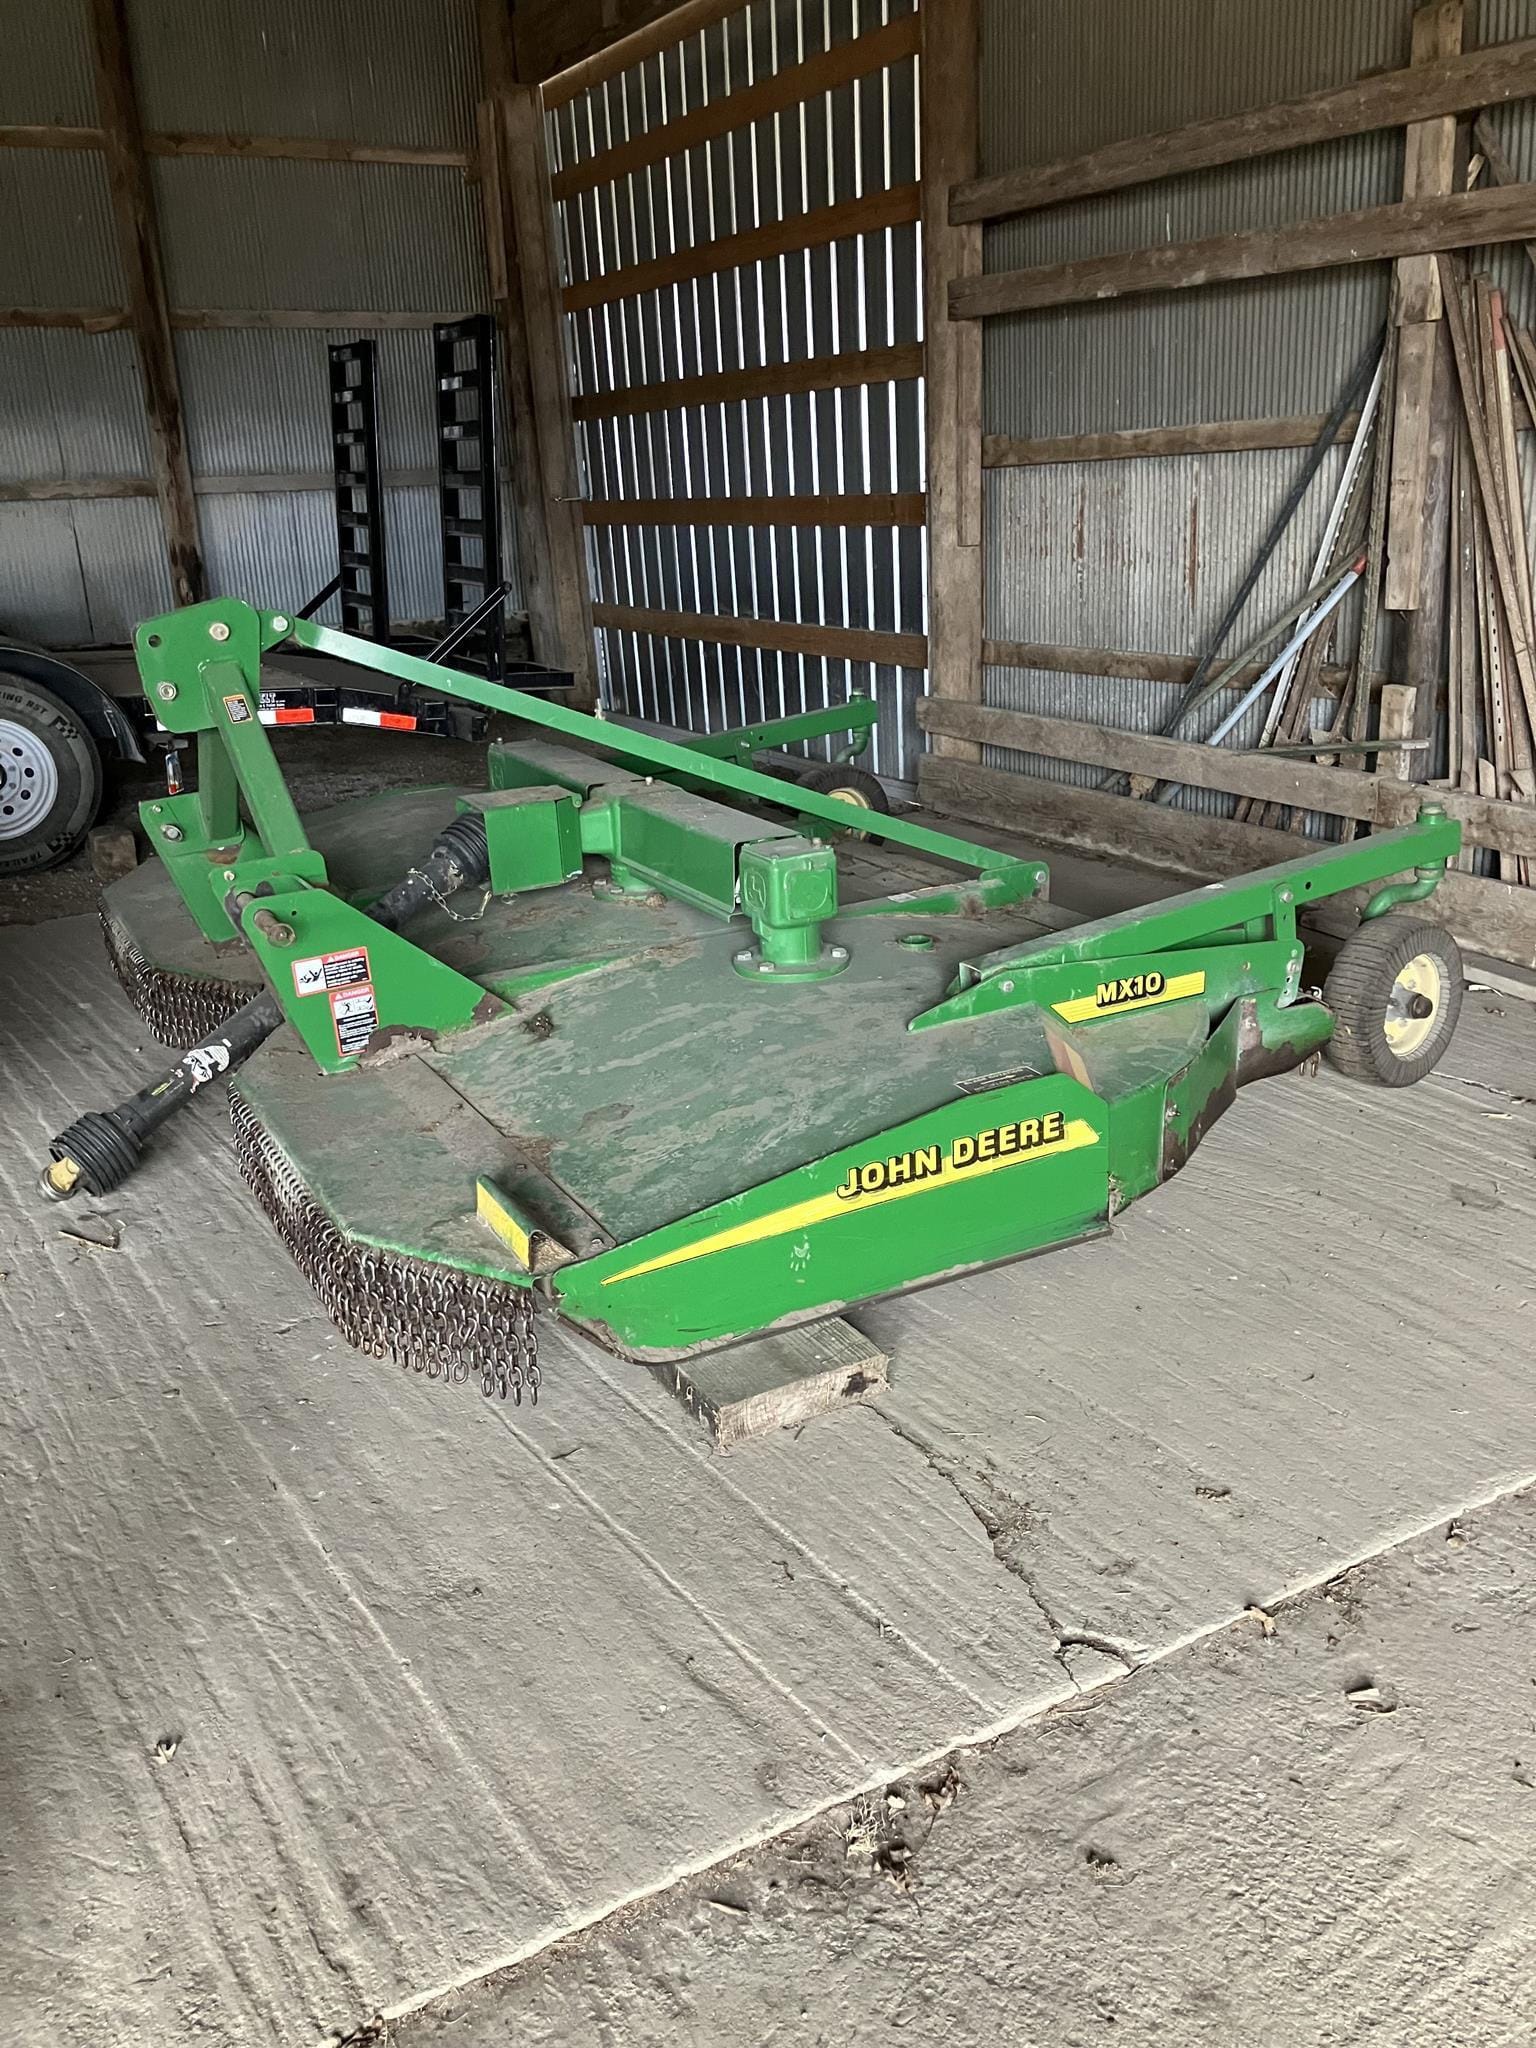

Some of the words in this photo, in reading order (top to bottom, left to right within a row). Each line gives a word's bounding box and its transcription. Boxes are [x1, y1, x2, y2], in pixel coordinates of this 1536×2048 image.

[0, 691, 23, 703] ING
[1096, 972, 1165, 1008] MX10
[836, 1145, 941, 1198] JOHN
[952, 1111, 1064, 1169] DEERE
